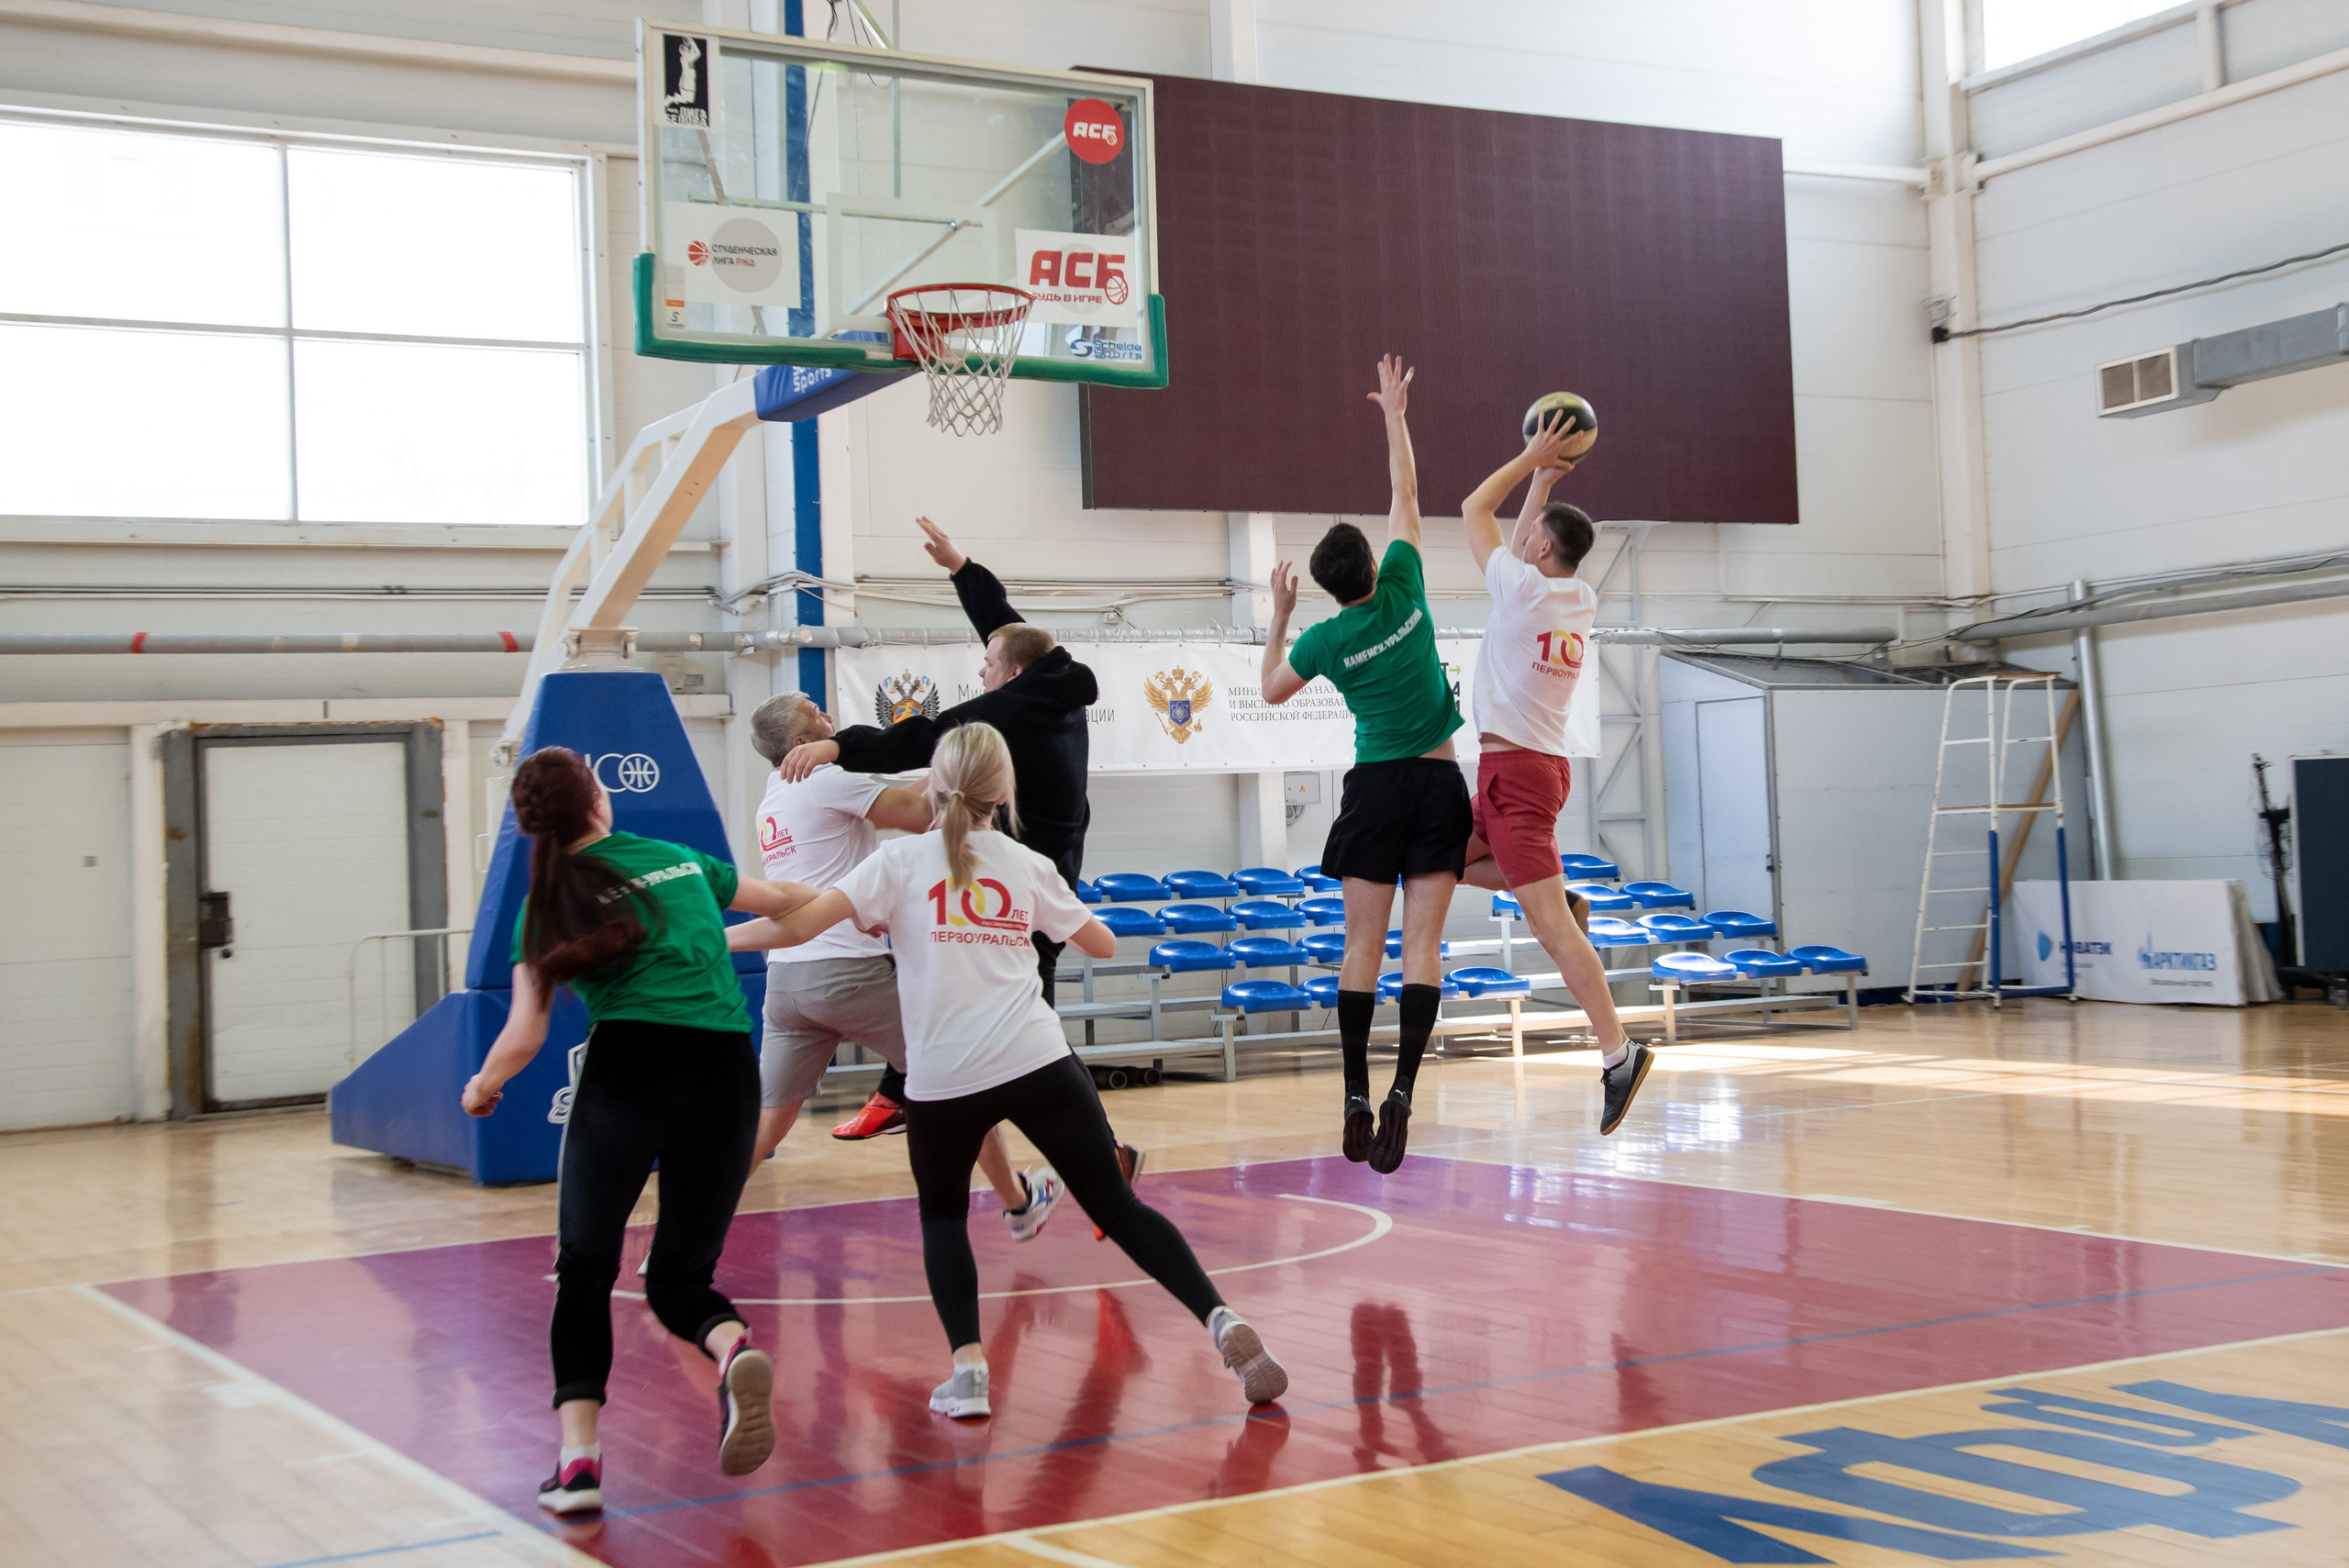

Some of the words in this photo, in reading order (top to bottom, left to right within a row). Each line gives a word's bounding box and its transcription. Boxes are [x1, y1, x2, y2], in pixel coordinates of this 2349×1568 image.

[1073, 121, 1118, 146] АСБ
[711, 243, 778, 256] СТУДЕНЧЕСКАЯ
[712, 256, 735, 265] ЛИГА
[735, 257, 755, 267] РЖД
[1029, 250, 1129, 306] АСБ
[1063, 294, 1072, 302] В
[1074, 295, 1102, 304] ИГРЕ
[1094, 348, 1142, 360] Sports
[793, 367, 833, 395] Sports
[1536, 629, 1585, 669] 100
[1314, 685, 1340, 695] НАУ
[1229, 701, 1236, 709] И
[1292, 697, 1346, 708] ОБРАЗОВАН
[1230, 710, 1300, 721] РОССИЙСКОЙ
[928, 877, 1012, 929] 100
[1010, 909, 1029, 920] ЛЕТ
[930, 931, 1030, 947] ПЕРВОУРАЛЬСК
[2059, 941, 2112, 955] НВАТЭК
